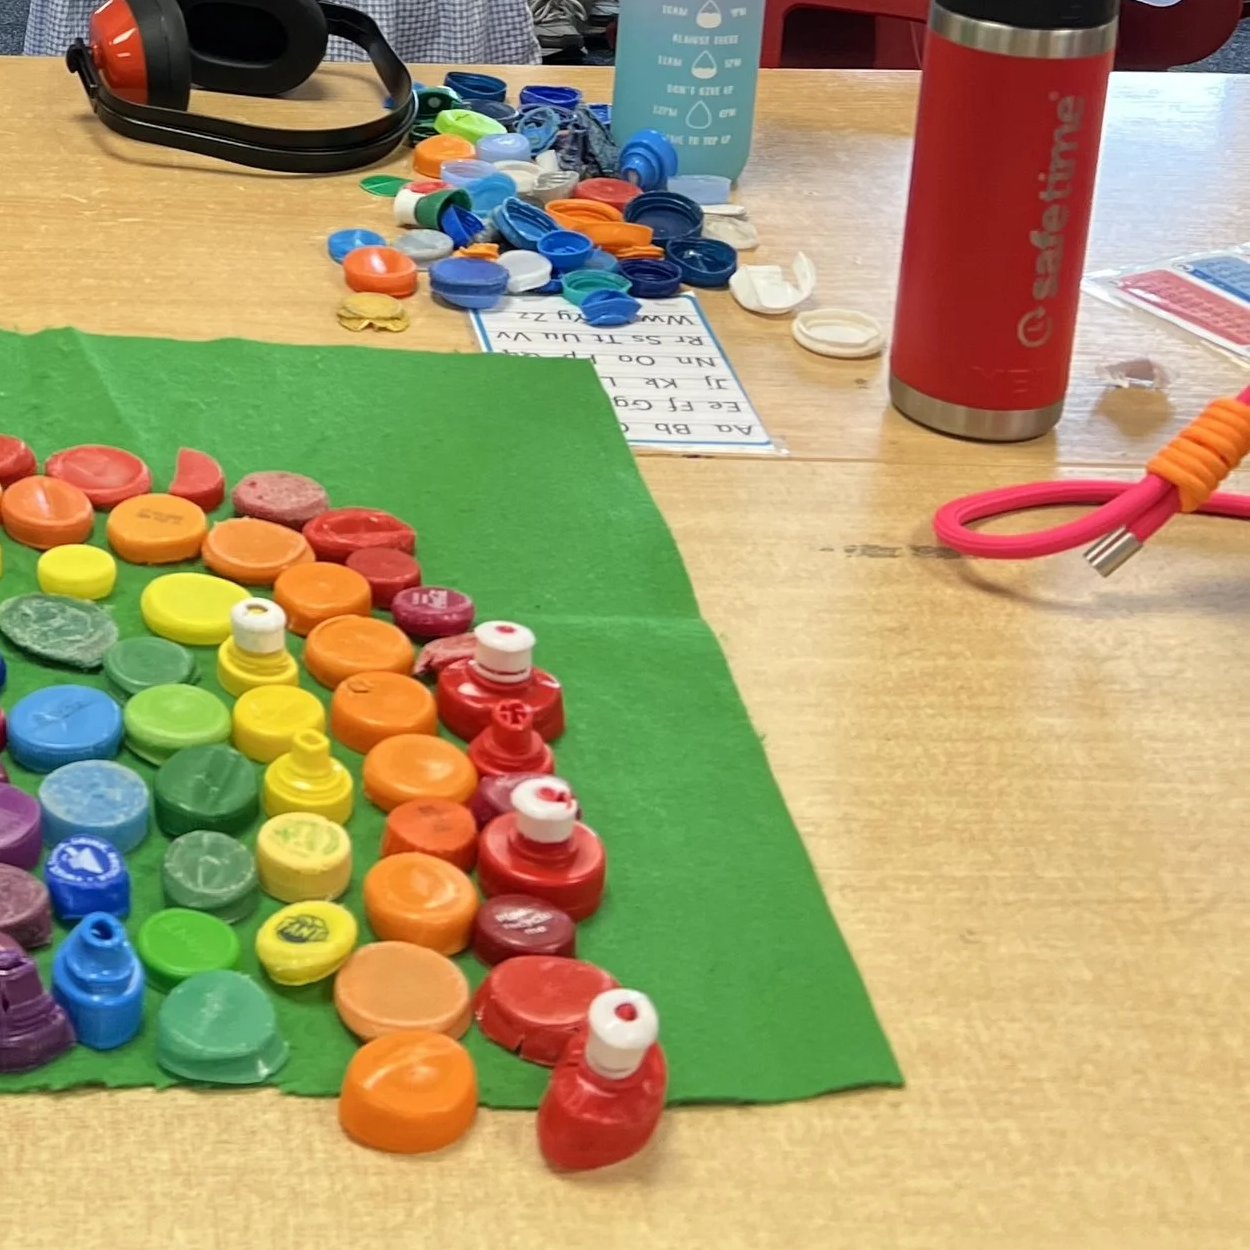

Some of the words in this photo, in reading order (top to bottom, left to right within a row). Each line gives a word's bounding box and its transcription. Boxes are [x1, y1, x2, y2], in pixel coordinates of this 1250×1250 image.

[1029, 94, 1085, 300] safetime
[518, 311, 550, 323] Zz
[497, 331, 532, 343] Vv
[542, 332, 581, 344] Uu
[595, 332, 623, 345] Tt
[632, 334, 662, 346] Ss
[677, 335, 704, 347] Rr
[618, 354, 656, 367] Oo
[677, 356, 718, 368] Nn
[644, 376, 678, 389] Kk
[613, 395, 653, 412] Gg
[667, 397, 694, 413] Ff
[709, 400, 742, 413] Ee
[655, 422, 691, 436] Bb
[715, 424, 754, 437] Aa
